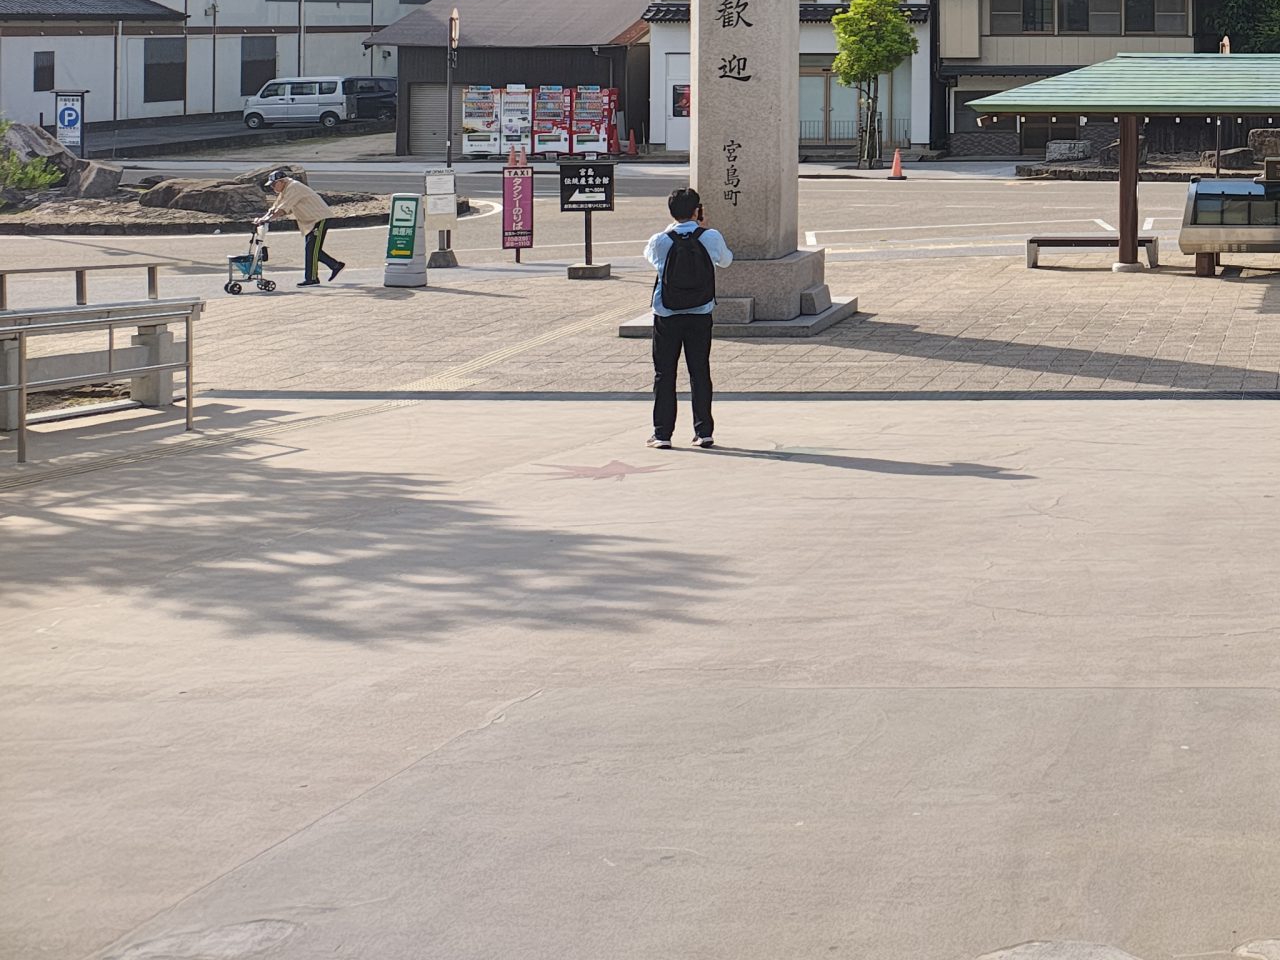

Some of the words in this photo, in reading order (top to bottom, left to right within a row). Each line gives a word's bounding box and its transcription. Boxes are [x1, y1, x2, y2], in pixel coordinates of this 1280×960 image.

[64, 110, 77, 126] P
[722, 140, 743, 207] 宮島町
[512, 177, 523, 231] タクシーのりば
